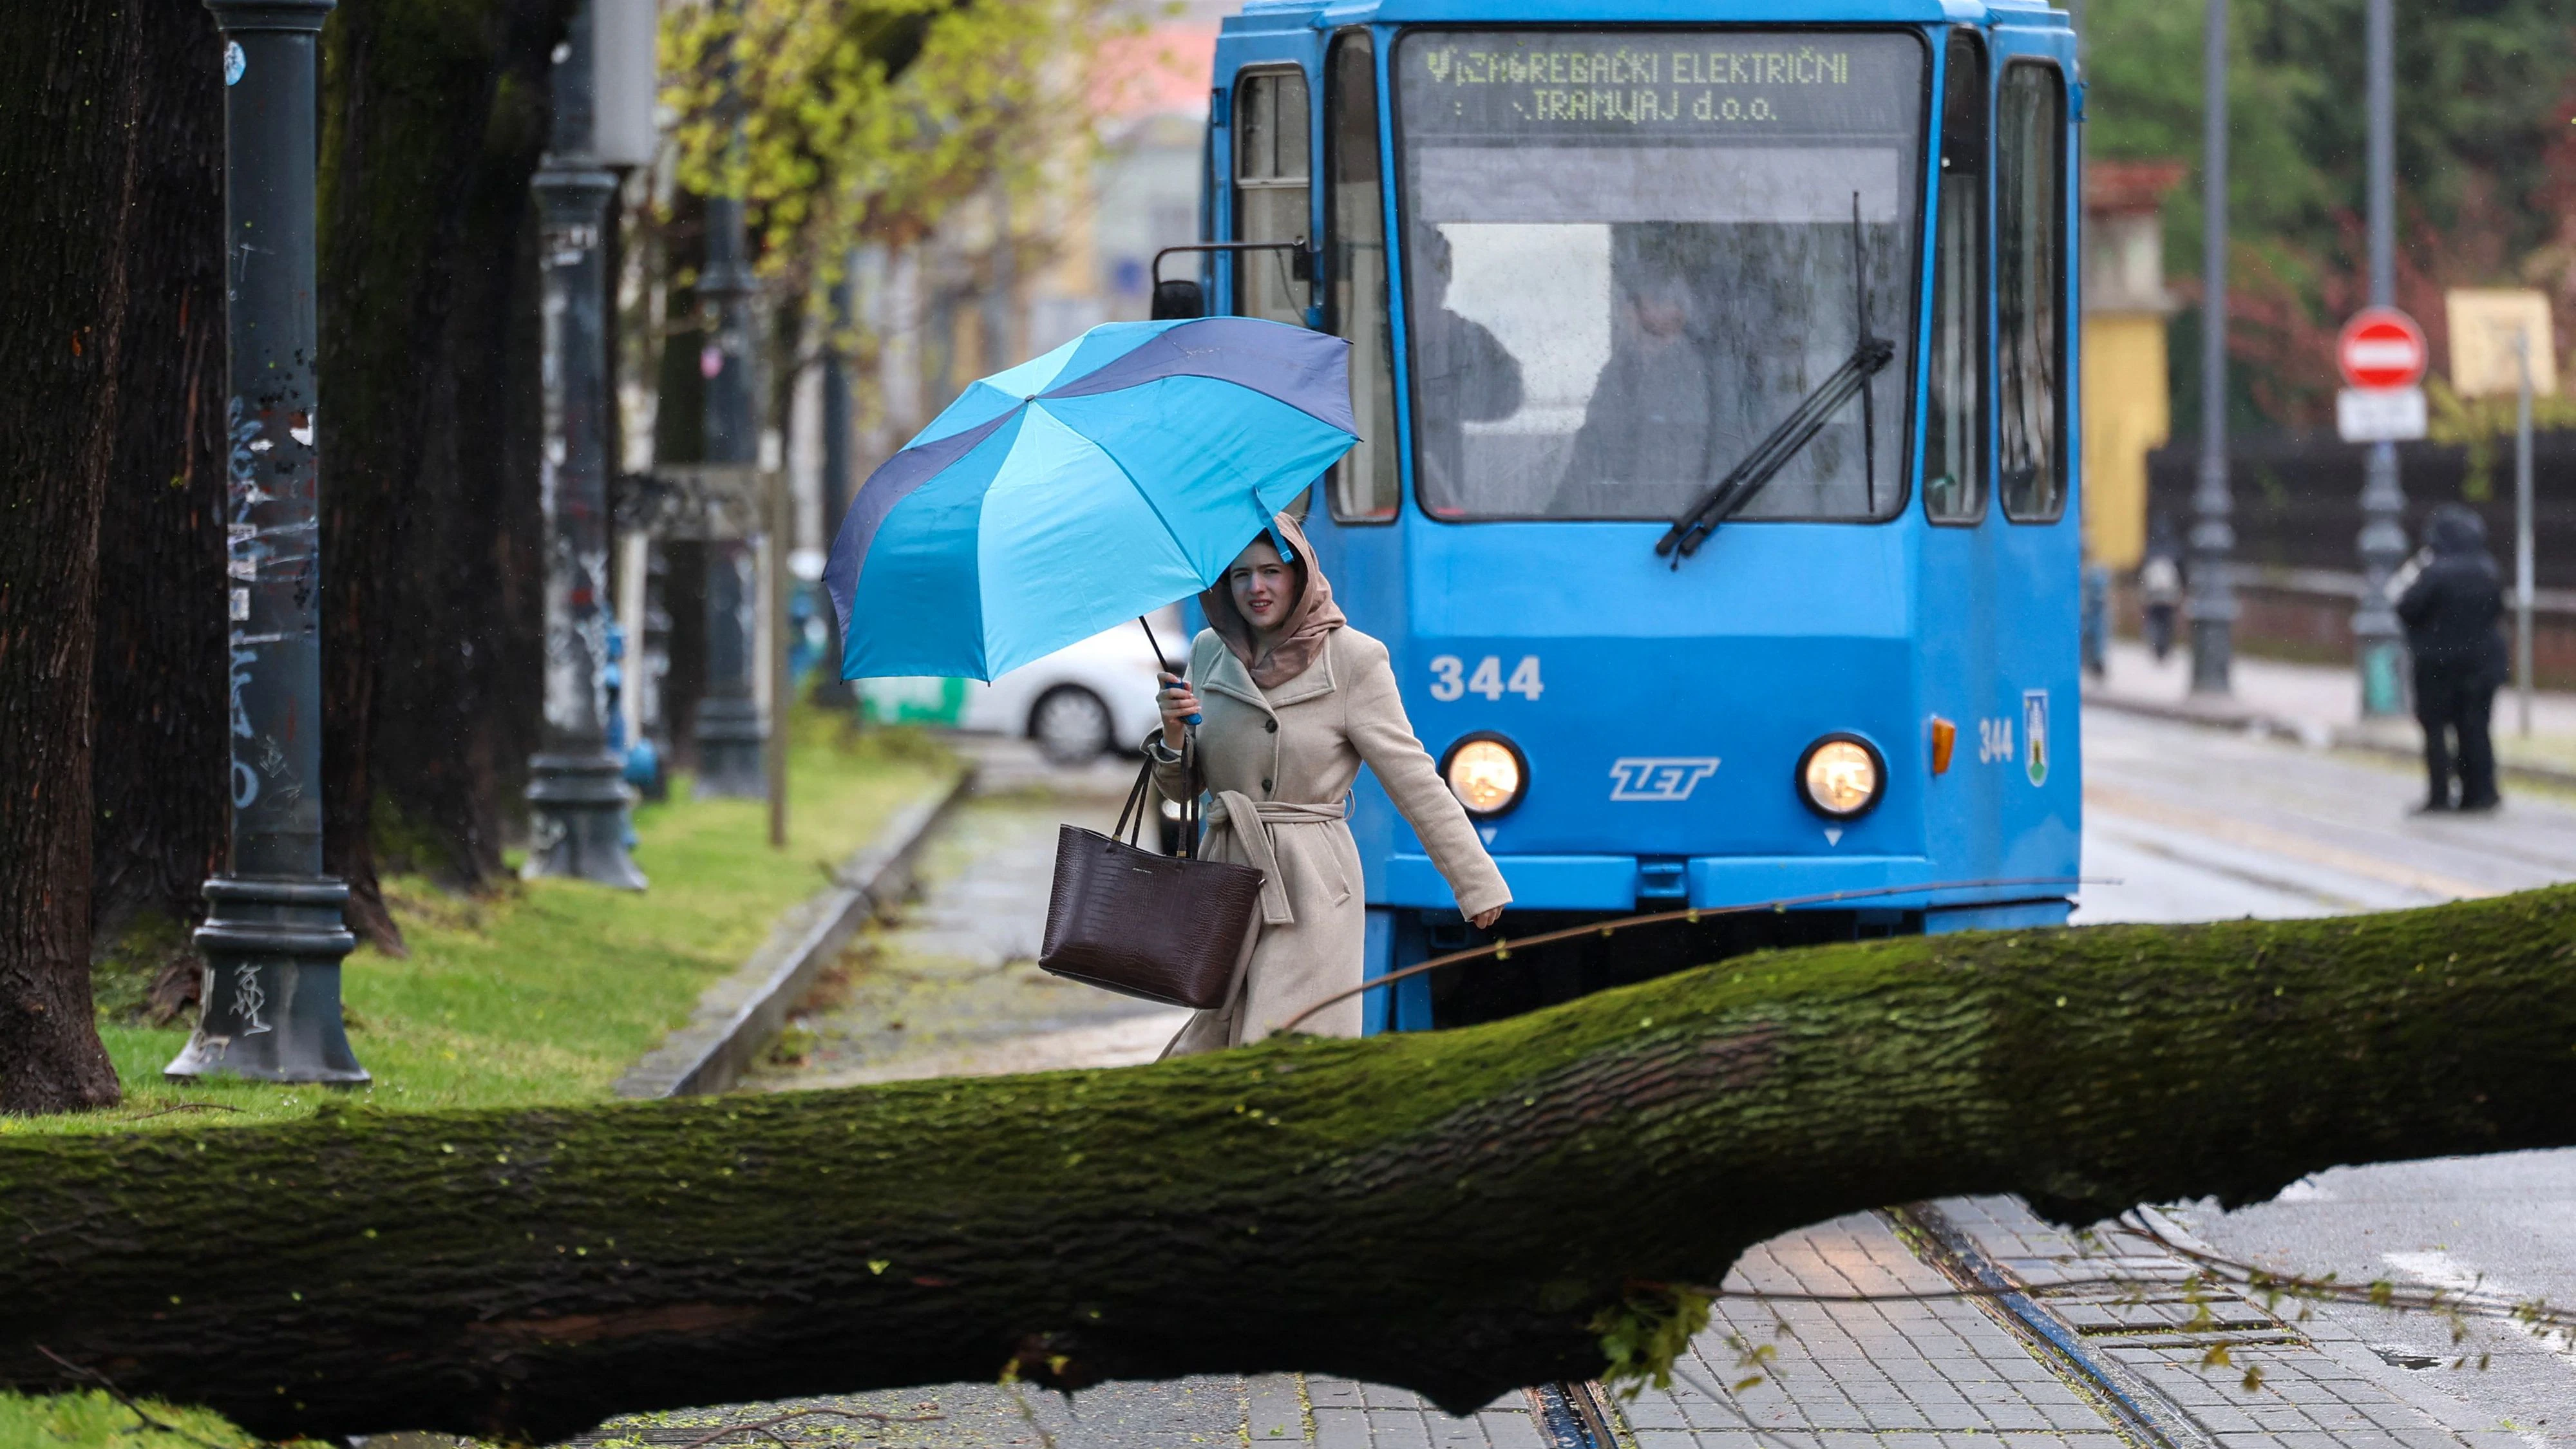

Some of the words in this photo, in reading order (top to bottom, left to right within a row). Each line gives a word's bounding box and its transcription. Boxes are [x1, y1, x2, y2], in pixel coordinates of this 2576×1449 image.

[1672, 46, 1848, 84] ELEKTRIČNI
[1534, 89, 1679, 122] TRAMVAJ
[1692, 90, 1777, 121] d.o.o.
[1429, 654, 1544, 702] 344
[1978, 716, 2014, 764] 344
[1610, 757, 1721, 801] ZET
